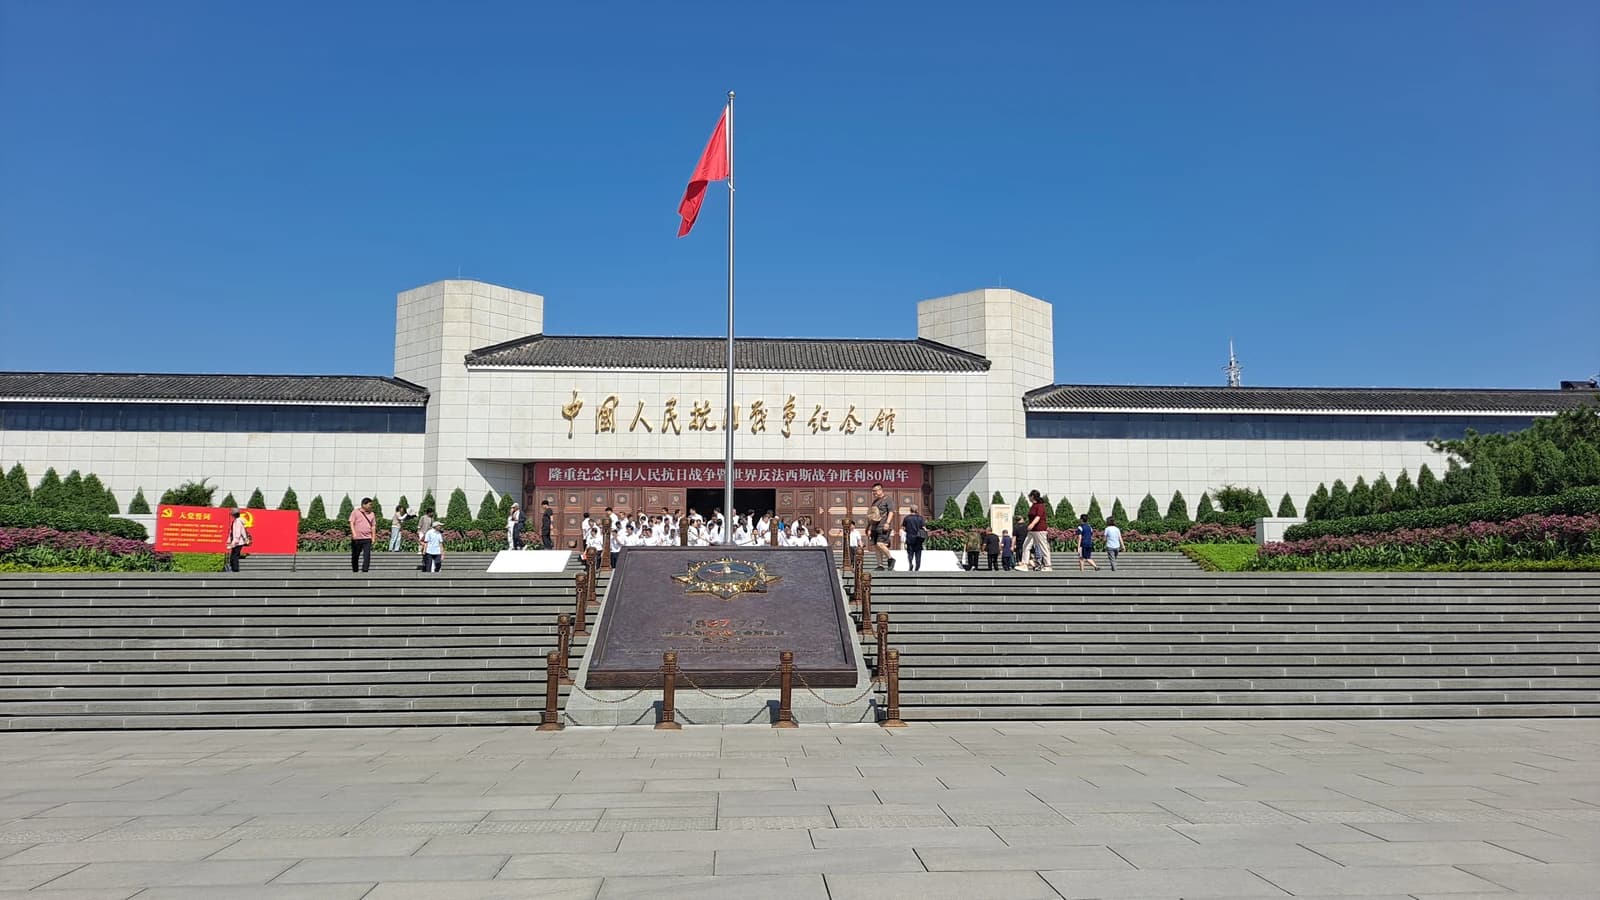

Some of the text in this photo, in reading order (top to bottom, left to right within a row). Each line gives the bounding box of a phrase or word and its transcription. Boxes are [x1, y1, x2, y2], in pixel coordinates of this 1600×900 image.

[548, 468, 909, 483] 隆重纪念中国人民抗日战争暨世界反法西斯战争胜利80周年
